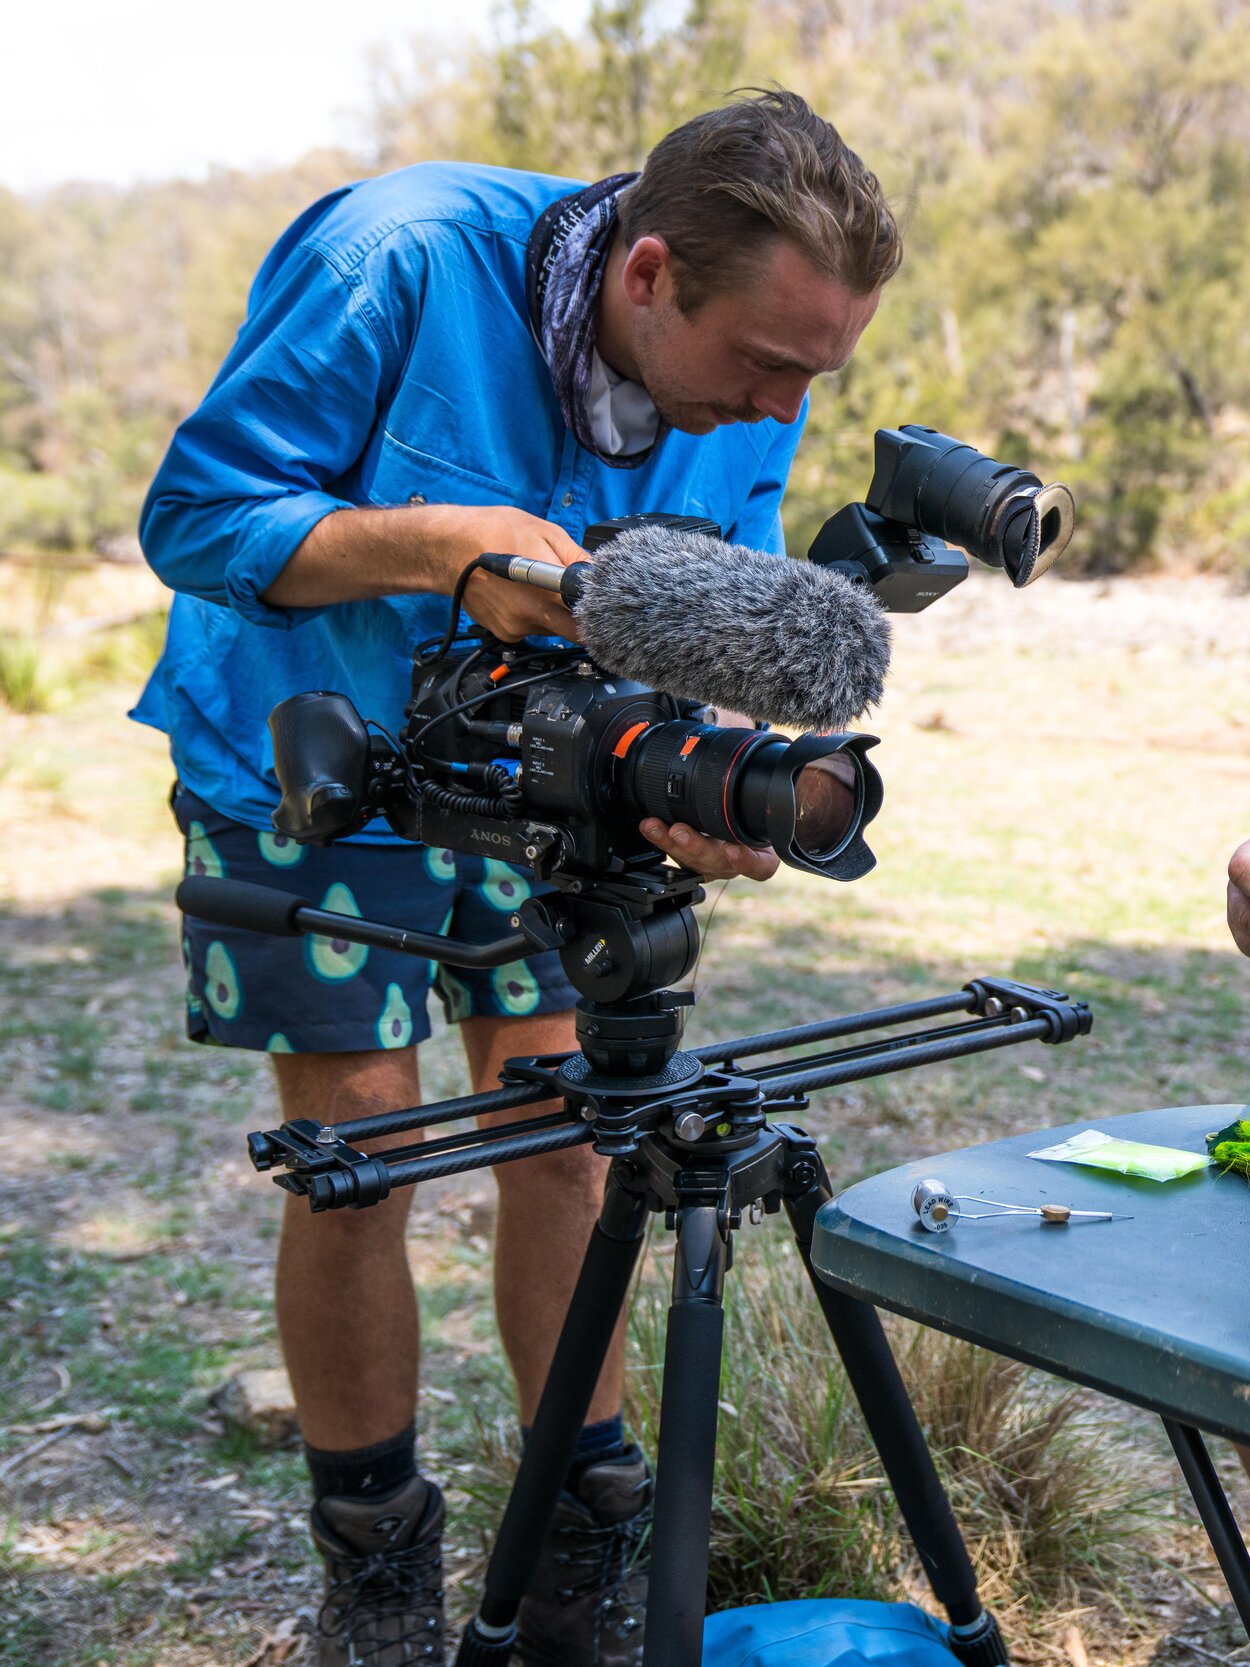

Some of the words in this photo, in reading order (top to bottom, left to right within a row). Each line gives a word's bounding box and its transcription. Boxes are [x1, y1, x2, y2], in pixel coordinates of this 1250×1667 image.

[555, 206, 588, 248] RIGHT
[470, 828, 512, 847] SONY
[584, 941, 604, 965] MILLER
